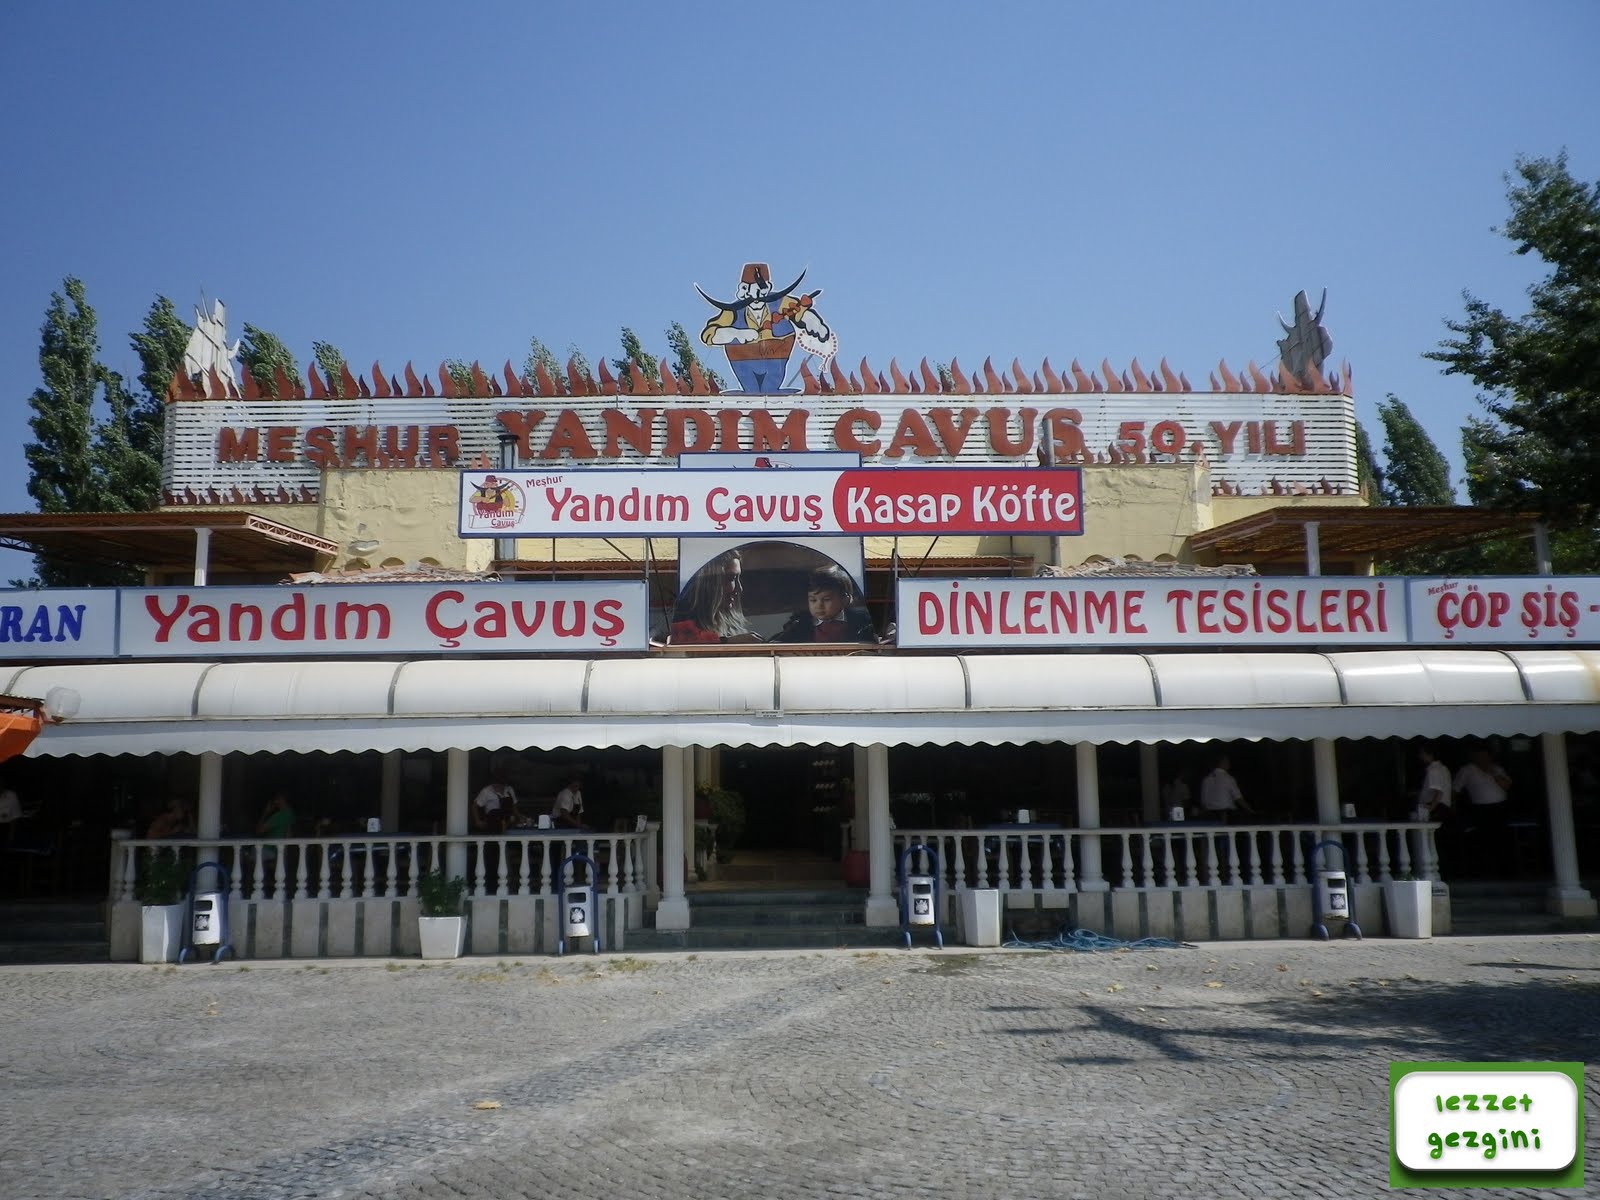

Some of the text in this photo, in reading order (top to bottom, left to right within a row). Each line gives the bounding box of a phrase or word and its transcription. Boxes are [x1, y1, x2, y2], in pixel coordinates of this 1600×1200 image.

[495, 408, 811, 459] YANDIM
[1208, 420, 1305, 455] YILI
[545, 484, 1076, 530] Yandım Çavuş Kasap Köfte
[0, 605, 87, 642] RAN
[145, 590, 625, 648] Yandım Çavuş
[918, 577, 1388, 636] DİNLENME TESİSLERİ
[1437, 585, 1511, 639] ÇÖP
[1521, 584, 1581, 638] ŞİŞ
